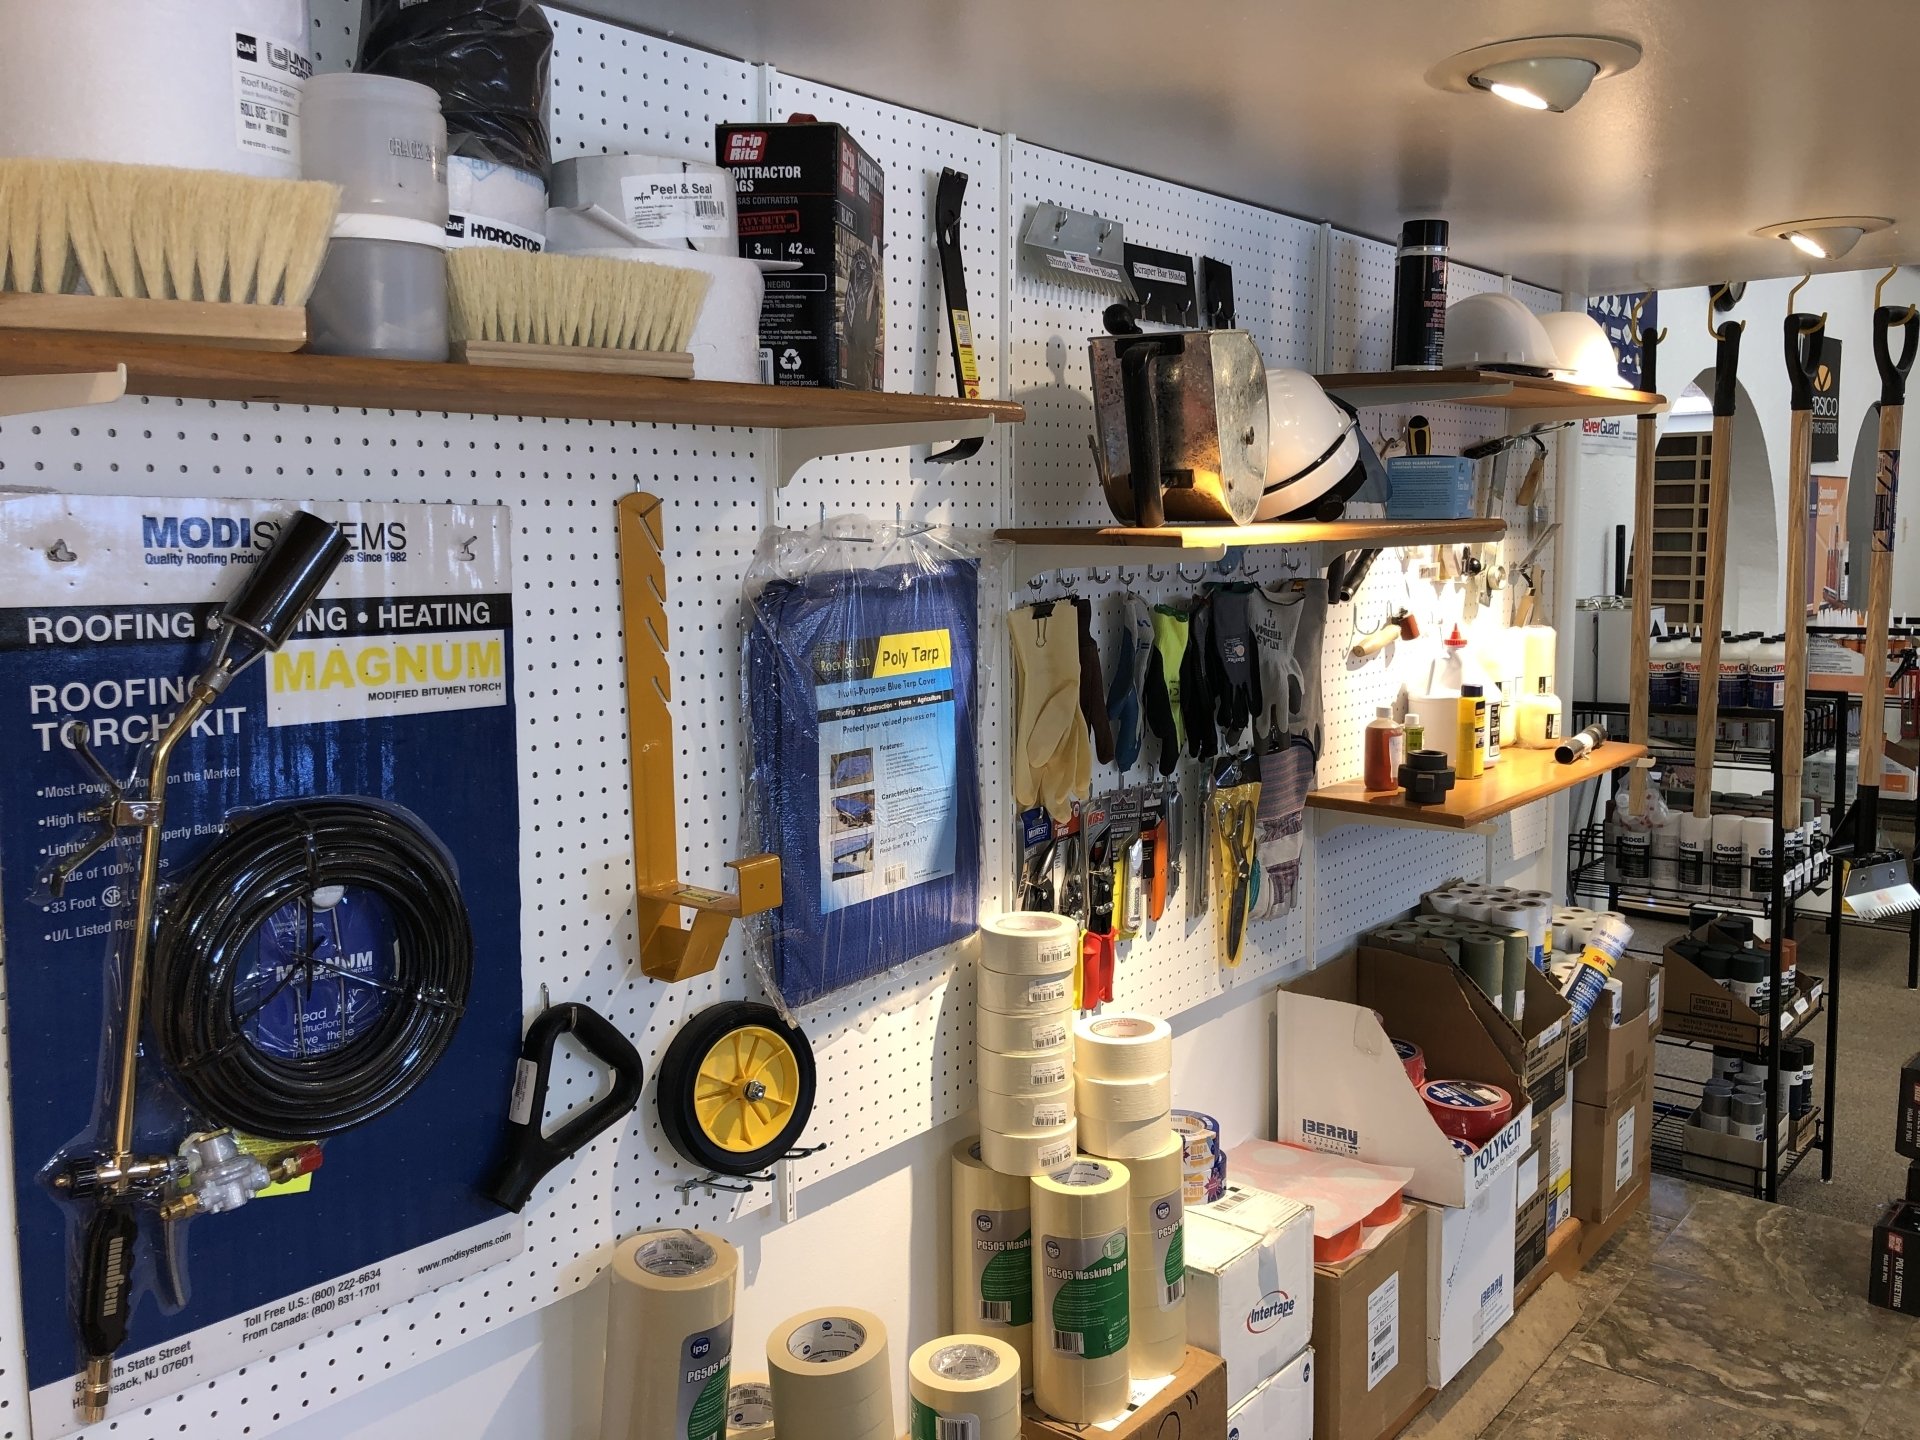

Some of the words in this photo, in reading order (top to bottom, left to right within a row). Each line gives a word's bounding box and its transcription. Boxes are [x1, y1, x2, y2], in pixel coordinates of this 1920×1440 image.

[236, 40, 256, 55] GAF
[241, 75, 260, 89] Roof
[240, 102, 254, 118] ROLL
[388, 137, 423, 160] CRACK
[731, 133, 763, 149] Grip
[729, 148, 759, 161] Rite
[650, 184, 677, 195] Peel
[680, 183, 690, 194] &
[691, 183, 712, 194] Seal
[752, 195, 799, 205] CONTRATISTA
[738, 215, 788, 227] EAVY-DUTY
[446, 220, 465, 231] GAF
[470, 222, 542, 254] HYDROSTOP
[754, 243, 762, 254] 3
[788, 243, 803, 254] 42
[1133, 263, 1157, 277] Scraper
[1157, 267, 1168, 277] Bar
[1168, 269, 1187, 282] Blades
[767, 281, 791, 289] NEGRO
[1583, 417, 1620, 435] EverGuard
[142, 515, 407, 551] MODISEMS
[145, 552, 184, 567] Quality
[186, 552, 228, 567] Roofing
[230, 552, 260, 565] Produ
[357, 552, 383, 563] Since
[384, 551, 407, 562] 1982
[378, 601, 491, 629] HEATING
[1262, 617, 1276, 629] FIT
[27, 612, 196, 644] ROOFING
[272, 640, 501, 693] MAGNUM
[882, 649, 909, 669] Poly
[911, 646, 939, 664] Tarp
[367, 689, 419, 702] MODIFIED
[421, 685, 466, 697] BITUMEN
[468, 682, 502, 693] TORCH
[887, 682, 902, 691] Blue
[918, 677, 937, 686] Cover
[835, 708, 856, 717] Roofing
[862, 702, 893, 713] Construction
[917, 695, 942, 704] Agriculture
[31, 713, 177, 751] TORCH
[190, 706, 247, 738] KIT
[842, 722, 865, 735] Protect
[866, 721, 880, 732] your
[881, 716, 902, 727] valued
[45, 785, 77, 799] Most
[167, 774, 181, 785] on
[183, 772, 201, 782] the
[203, 767, 240, 780] Market
[46, 815, 75, 828] High
[121, 835, 143, 845] and
[194, 823, 230, 836] Balanc
[87, 868, 99, 880] of
[101, 861, 135, 877] 100%
[51, 901, 67, 914] 33
[70, 896, 97, 909] Foot
[52, 929, 74, 943] U/L
[76, 923, 112, 938] Listed
[1592, 955, 1606, 966] 3M
[1695, 998, 1719, 1007] CONTENTS
[1302, 1118, 1358, 1146] BERRY
[1302, 1133, 1347, 1148] PLASTICS
[1302, 1137, 1358, 1155] CORPORATION
[1474, 1119, 1521, 1178] POLYKEN
[1474, 1172, 1489, 1190] Quality
[1488, 1164, 1500, 1176] Tapes
[1505, 1144, 1520, 1163] Industry
[1157, 1205, 1170, 1217] ipg
[978, 1218, 992, 1229] ipg
[1157, 1224, 1179, 1239] PG505
[416, 1231, 512, 1276] www.modisystems.com
[976, 1239, 1005, 1251] PG505
[1007, 1238, 1031, 1250] Maski
[1046, 1243, 1060, 1256] ipg
[1104, 1241, 1113, 1256] 1
[1047, 1266, 1074, 1280] PG505
[1075, 1265, 1112, 1281] Masking
[1112, 1258, 1127, 1274] Tape
[1895, 1256, 1905, 1276] POLY
[243, 1313, 261, 1329] Toll
[262, 1305, 286, 1324] Free
[287, 1295, 310, 1315] U.S.:
[311, 1286, 336, 1309] (800)
[337, 1268, 382, 1295] 222-6634
[1480, 1273, 1503, 1308] BERRY
[1892, 1275, 1904, 1308] SHEETING
[241, 1326, 268, 1344] From
[269, 1310, 310, 1335] Canada:
[310, 1301, 336, 1323] (800)
[337, 1282, 381, 1309] 831-1701
[1250, 1298, 1295, 1324] Intertape
[1379, 1314, 1392, 1328] Rolls
[126, 1352, 156, 1375] State
[157, 1340, 192, 1365] Street
[692, 1342, 709, 1355] ipg
[143, 1366, 159, 1381] NJ
[161, 1354, 195, 1375] 07601
[686, 1361, 720, 1383] PG505
